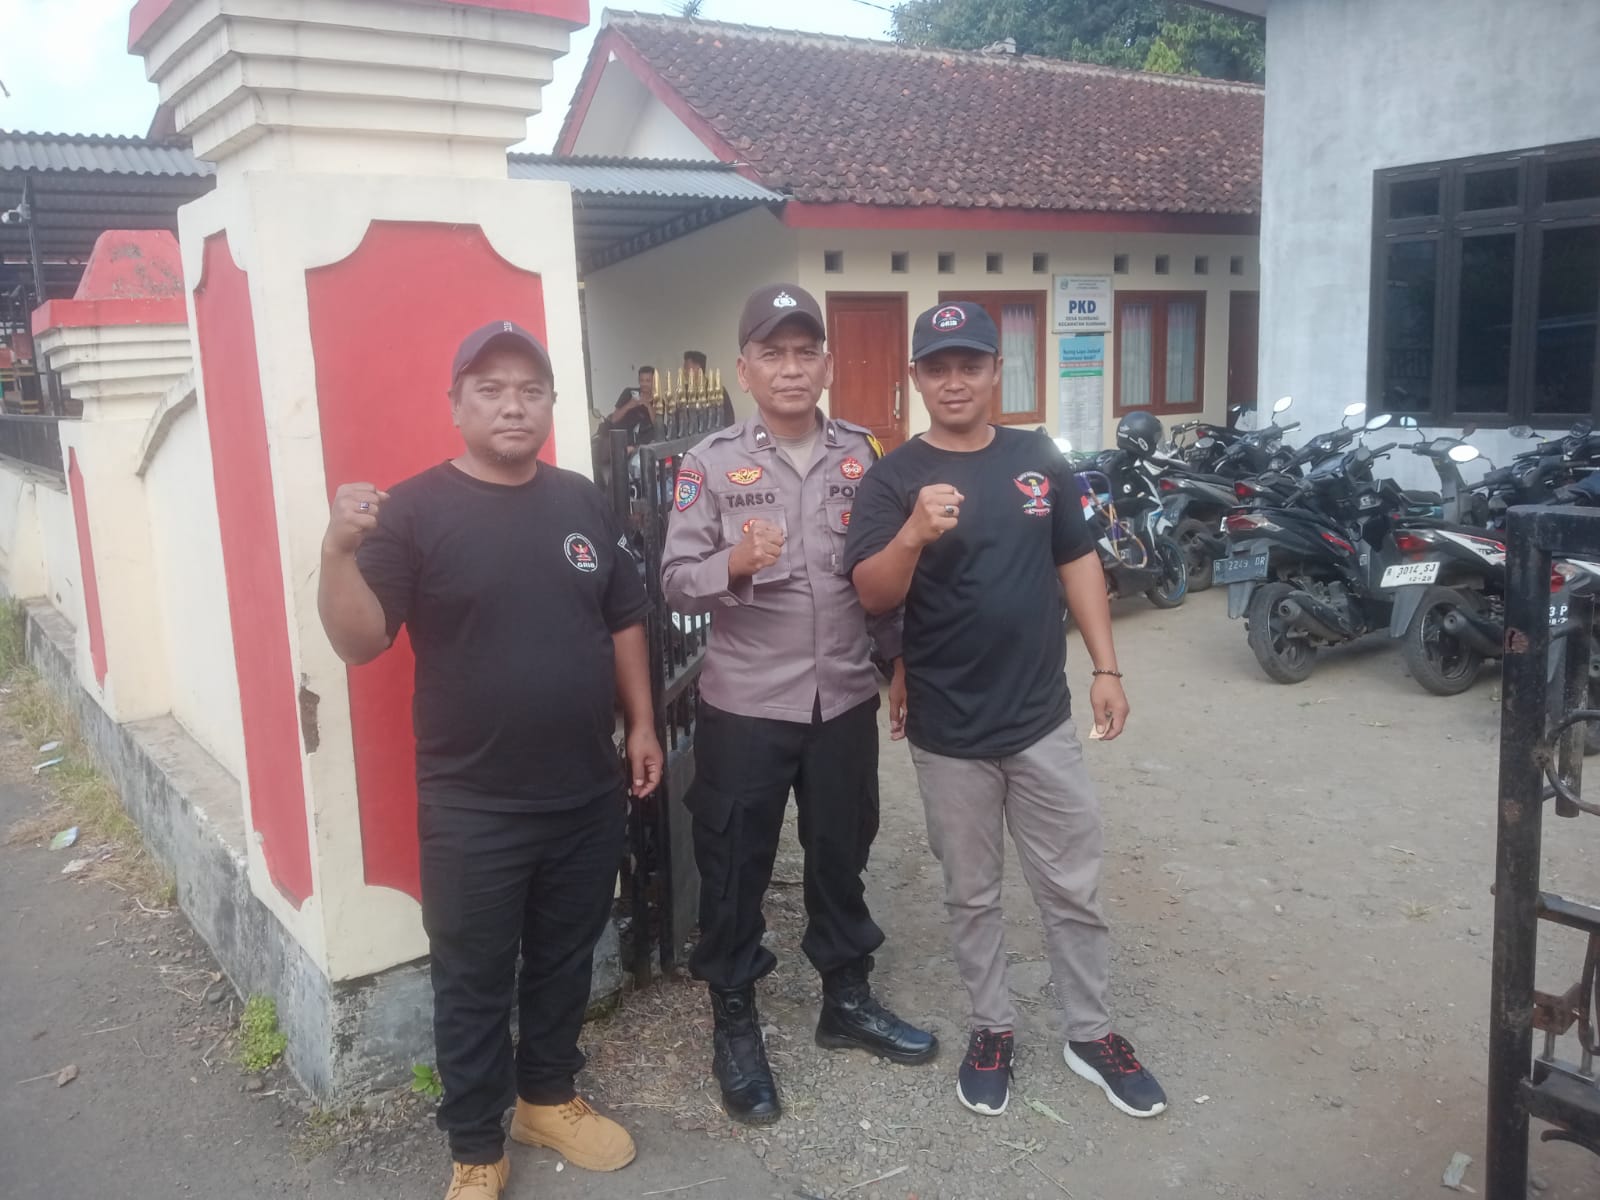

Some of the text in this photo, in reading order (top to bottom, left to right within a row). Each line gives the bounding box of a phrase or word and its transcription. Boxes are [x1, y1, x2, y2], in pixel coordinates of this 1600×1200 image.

[1069, 300, 1096, 314] PKD
[829, 484, 858, 498] PO
[726, 492, 776, 508] TARSO
